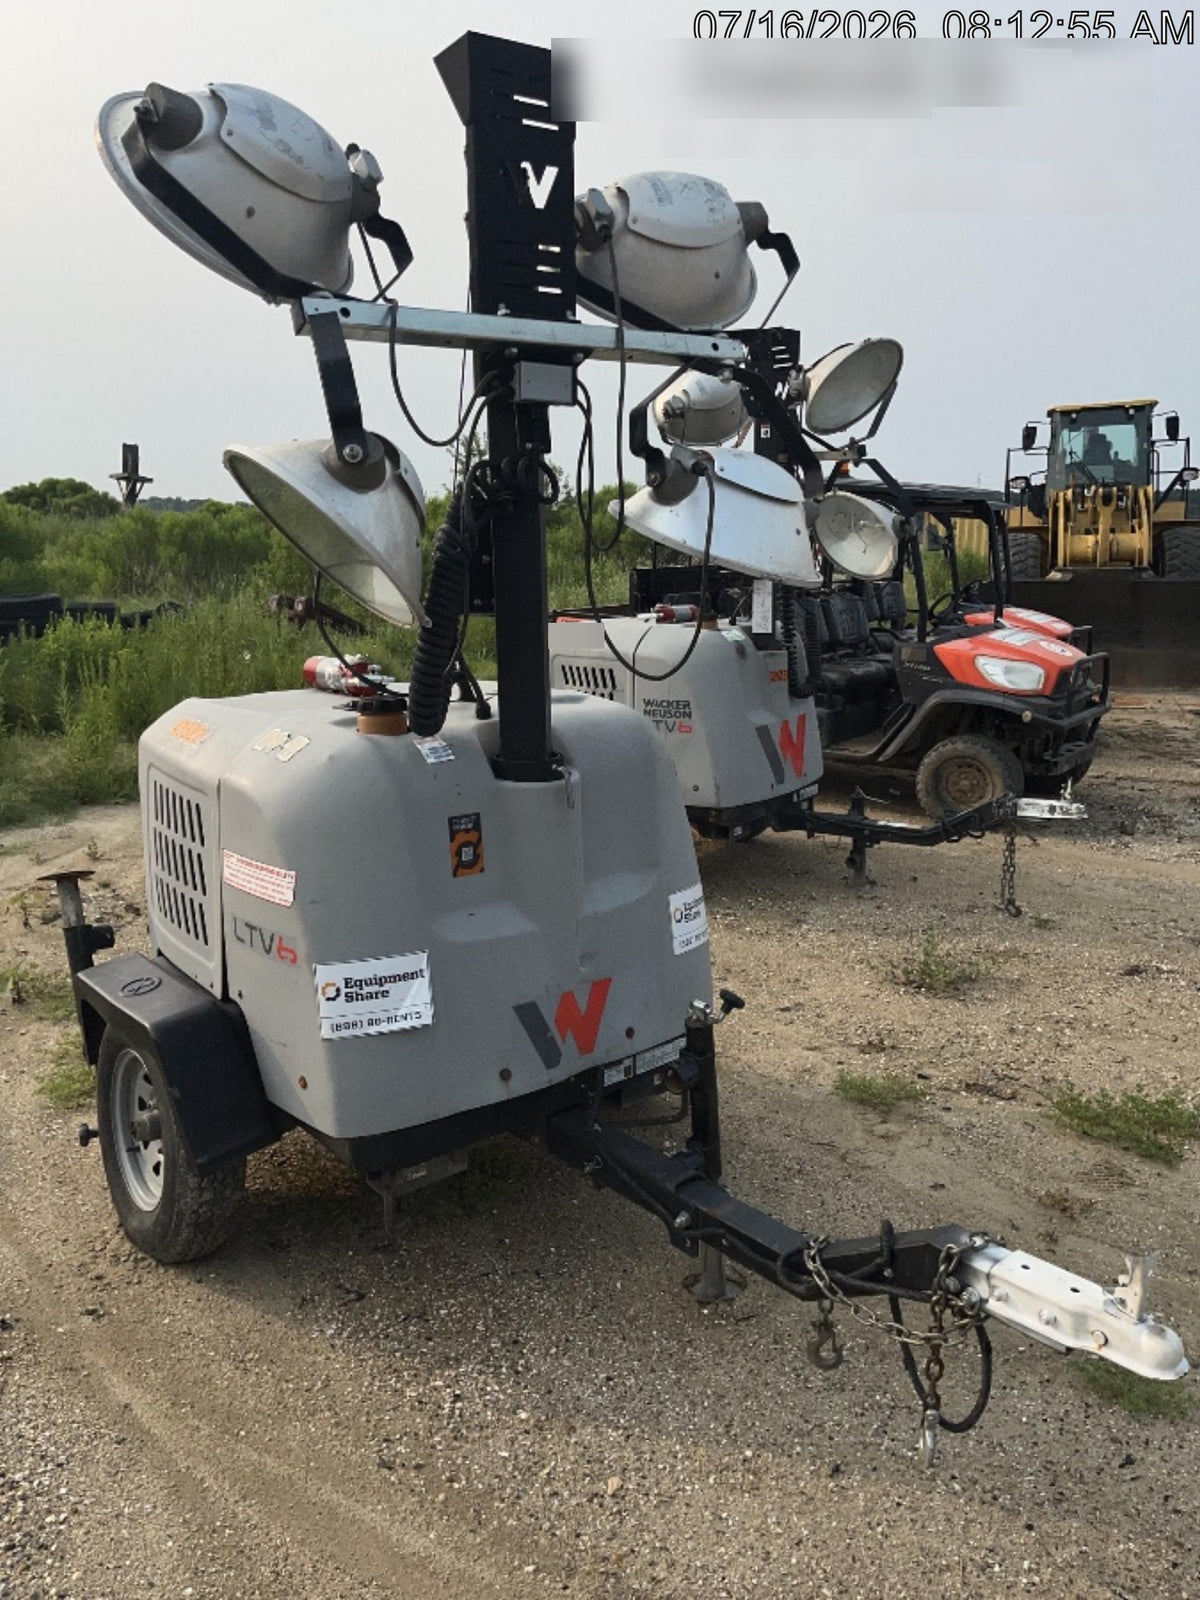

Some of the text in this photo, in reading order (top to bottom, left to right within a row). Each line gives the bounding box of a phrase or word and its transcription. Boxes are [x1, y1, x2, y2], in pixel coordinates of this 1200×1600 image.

[643, 698, 691, 710] WACKER
[643, 707, 693, 719] NEUSON
[652, 719, 693, 733] TV6
[233, 915, 298, 965] LTV6
[343, 968, 426, 991] Equipment
[343, 989, 390, 1004] Share
